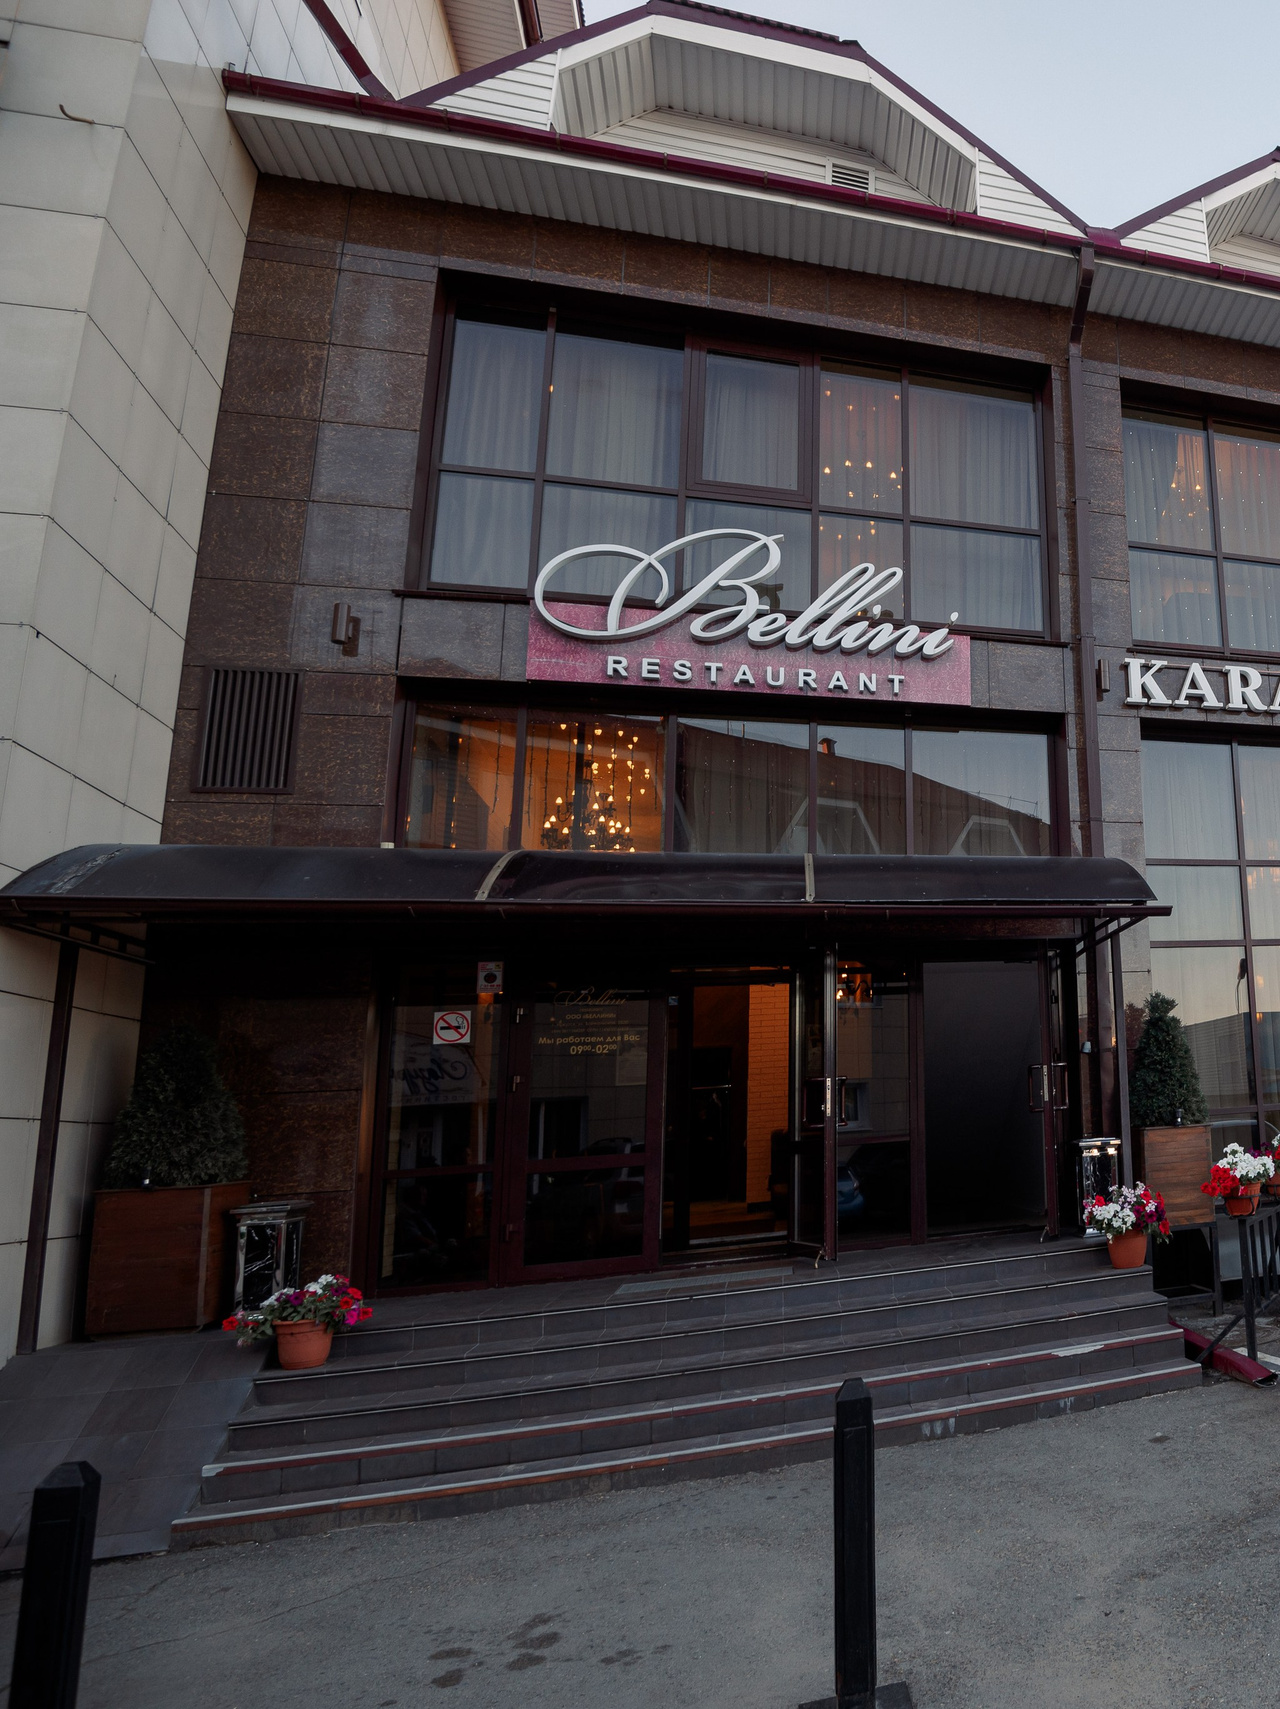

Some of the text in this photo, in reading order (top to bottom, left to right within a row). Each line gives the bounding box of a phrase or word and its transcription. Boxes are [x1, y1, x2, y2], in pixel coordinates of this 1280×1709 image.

[534, 528, 959, 658] Bellini
[606, 655, 905, 695] RESTAURANT
[556, 1035, 604, 1044] работаем
